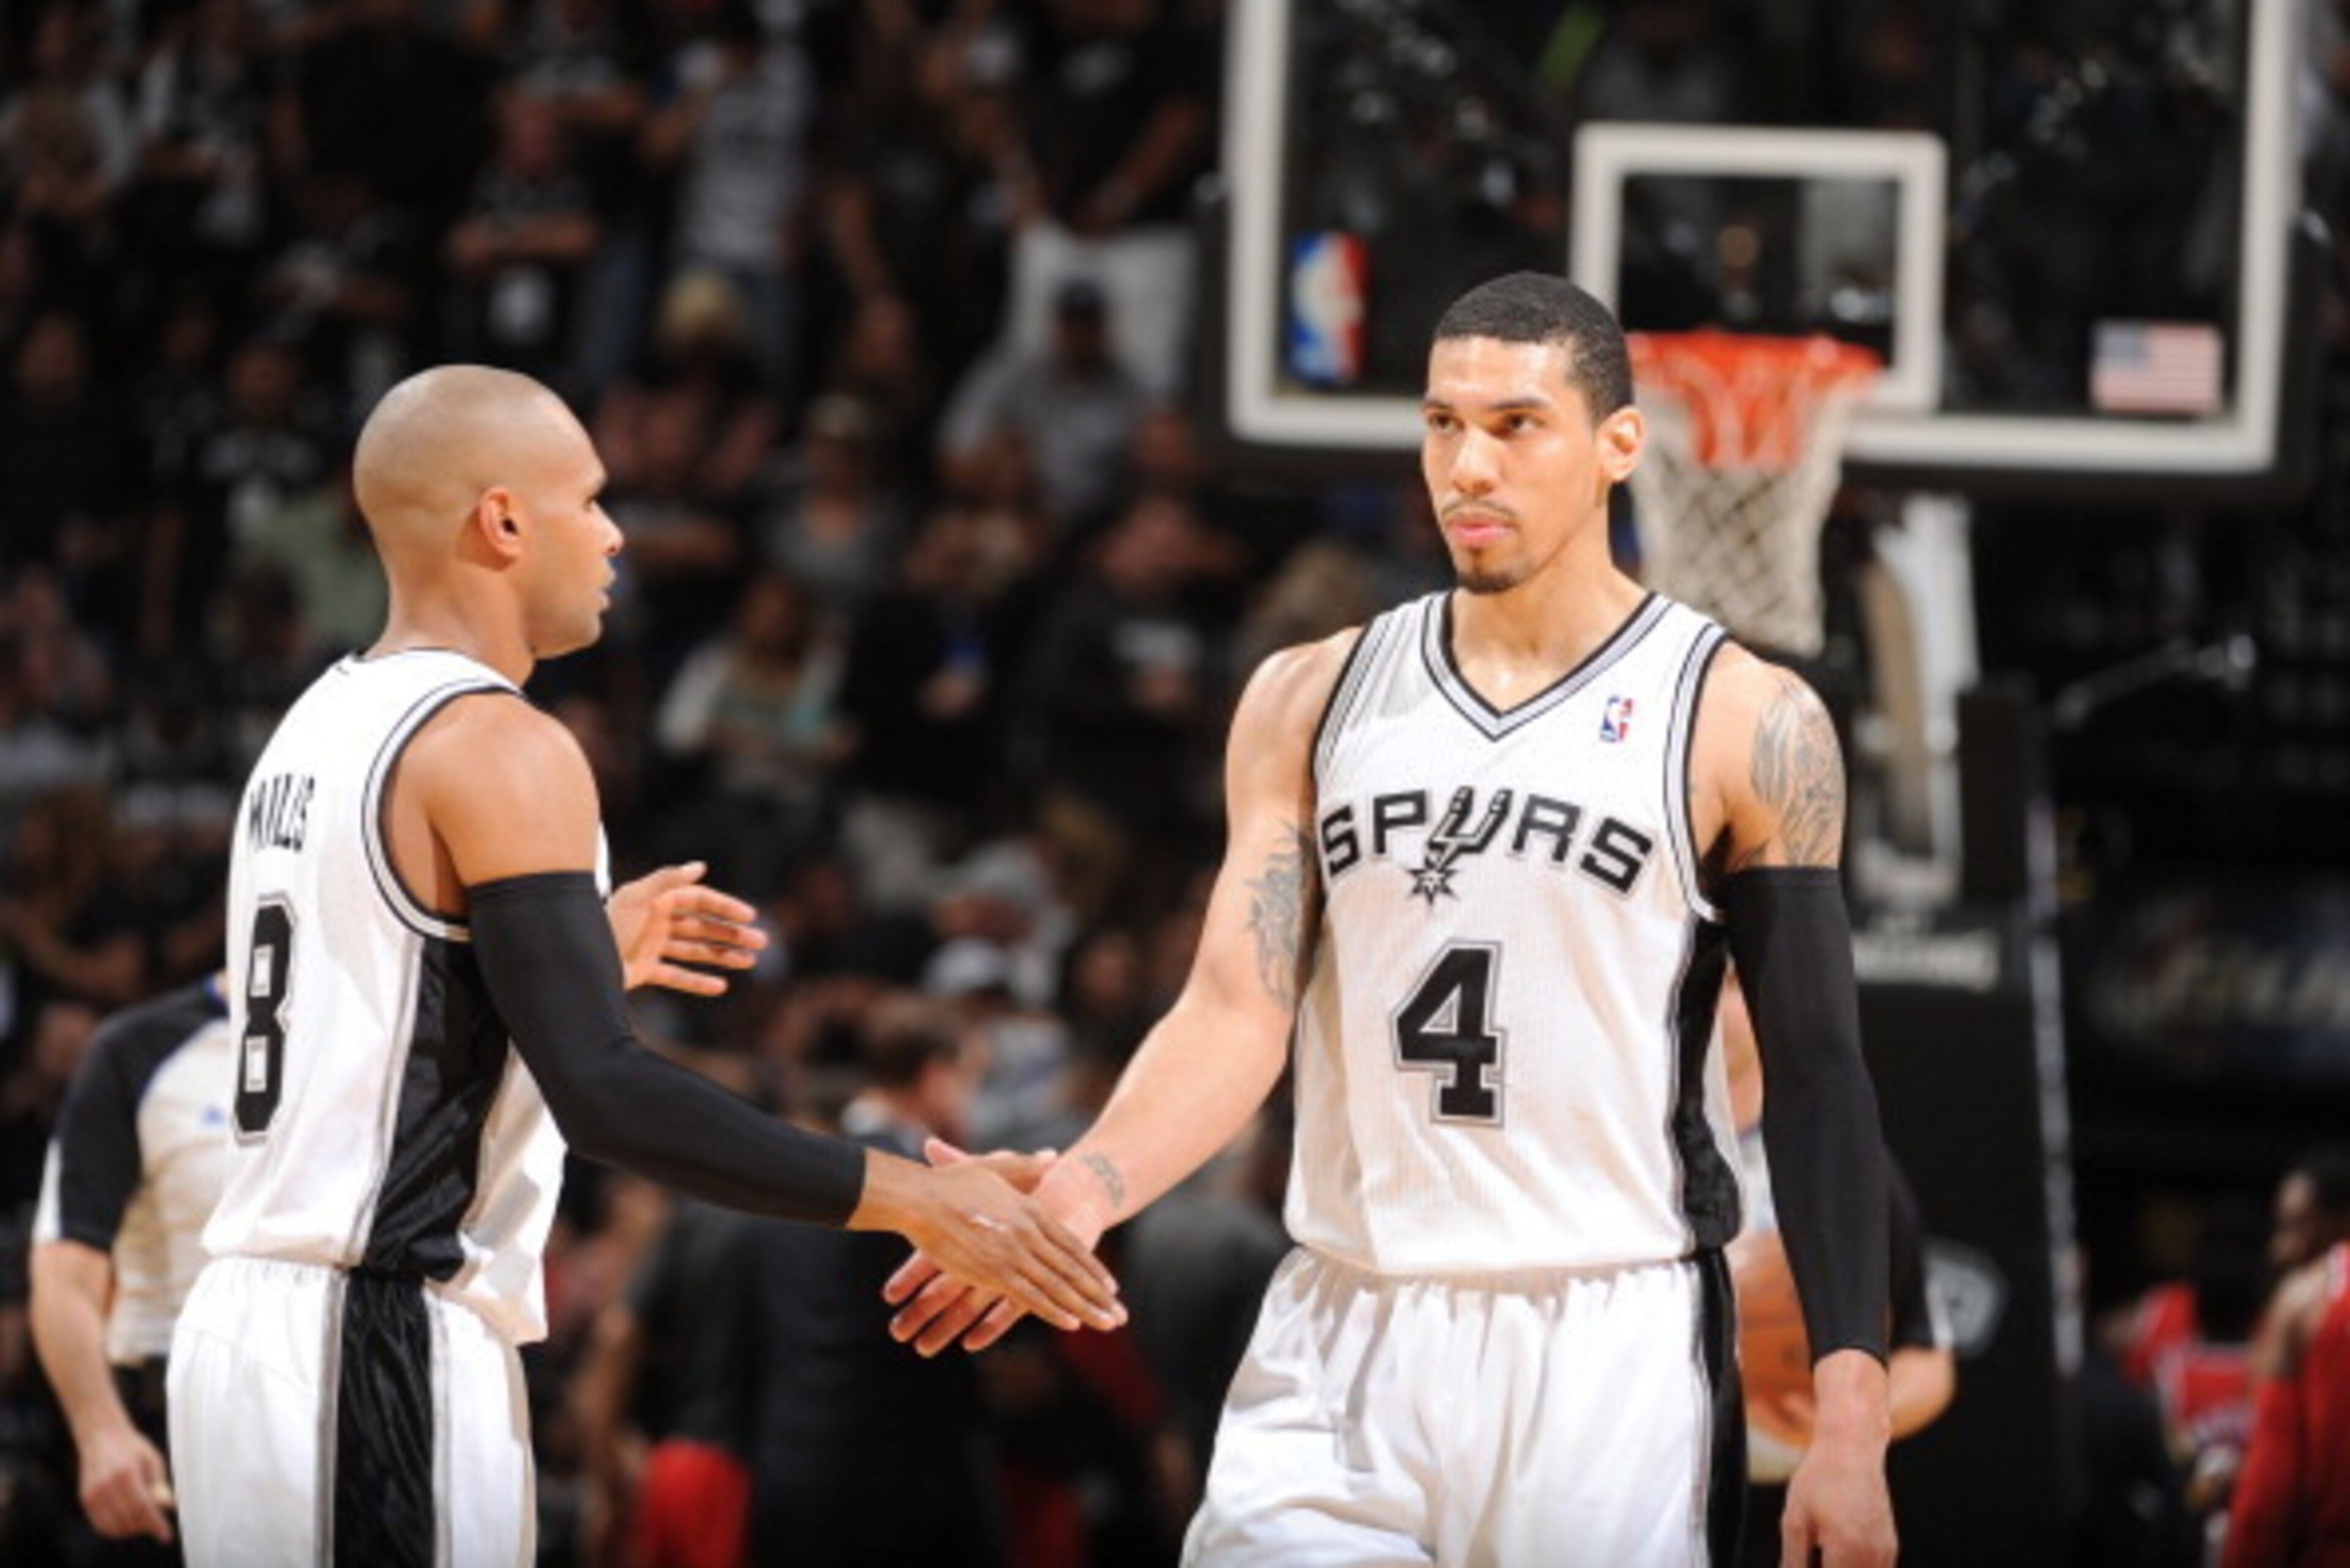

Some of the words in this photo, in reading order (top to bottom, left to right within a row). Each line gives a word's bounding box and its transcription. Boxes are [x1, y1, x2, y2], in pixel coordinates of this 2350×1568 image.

[1320, 785, 1655, 903] SPURS
[233, 891, 298, 1146] 8
[1389, 938, 1509, 1127] 4
